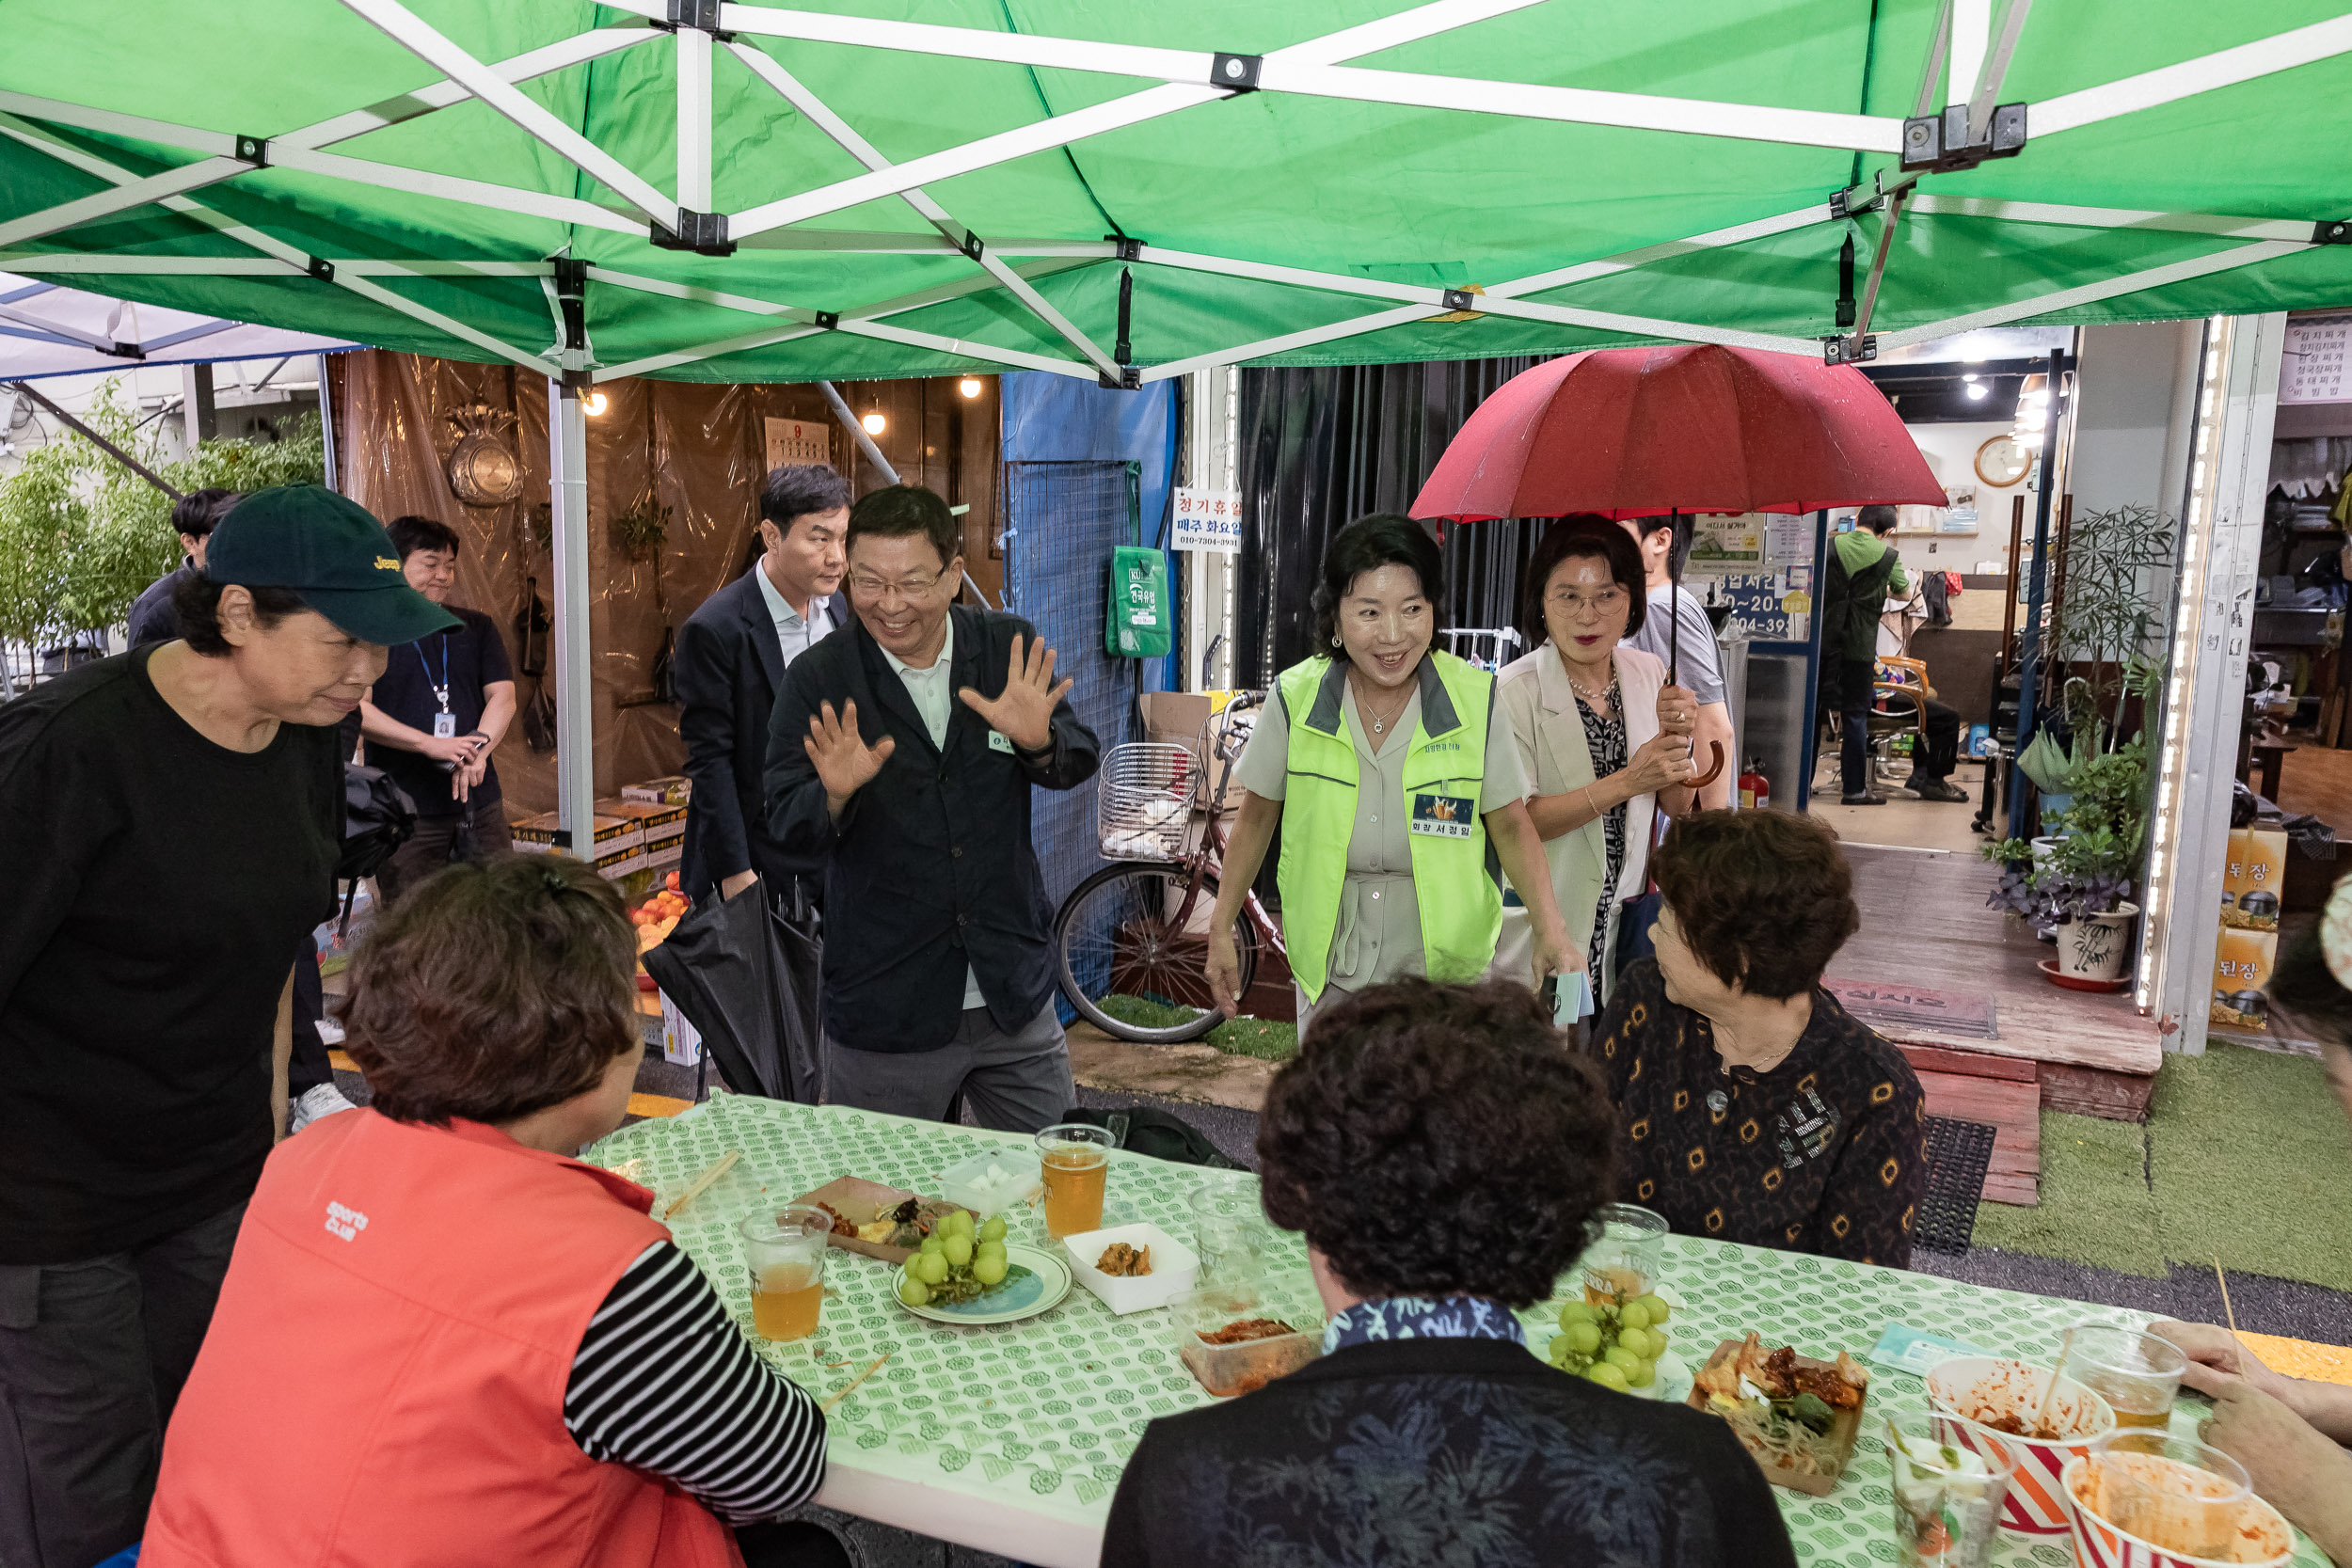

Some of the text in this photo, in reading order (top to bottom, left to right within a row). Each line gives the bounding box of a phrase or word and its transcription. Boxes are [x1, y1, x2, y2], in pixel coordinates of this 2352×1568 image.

[1179, 498, 1242, 516] 정기휴일
[1177, 518, 1242, 536] 매주 화요일
[1180, 536, 1238, 546] 010-7304-3931
[1131, 590, 1155, 605] 건국유업
[1412, 822, 1431, 832] 회장
[2219, 960, 2260, 980] 된장
